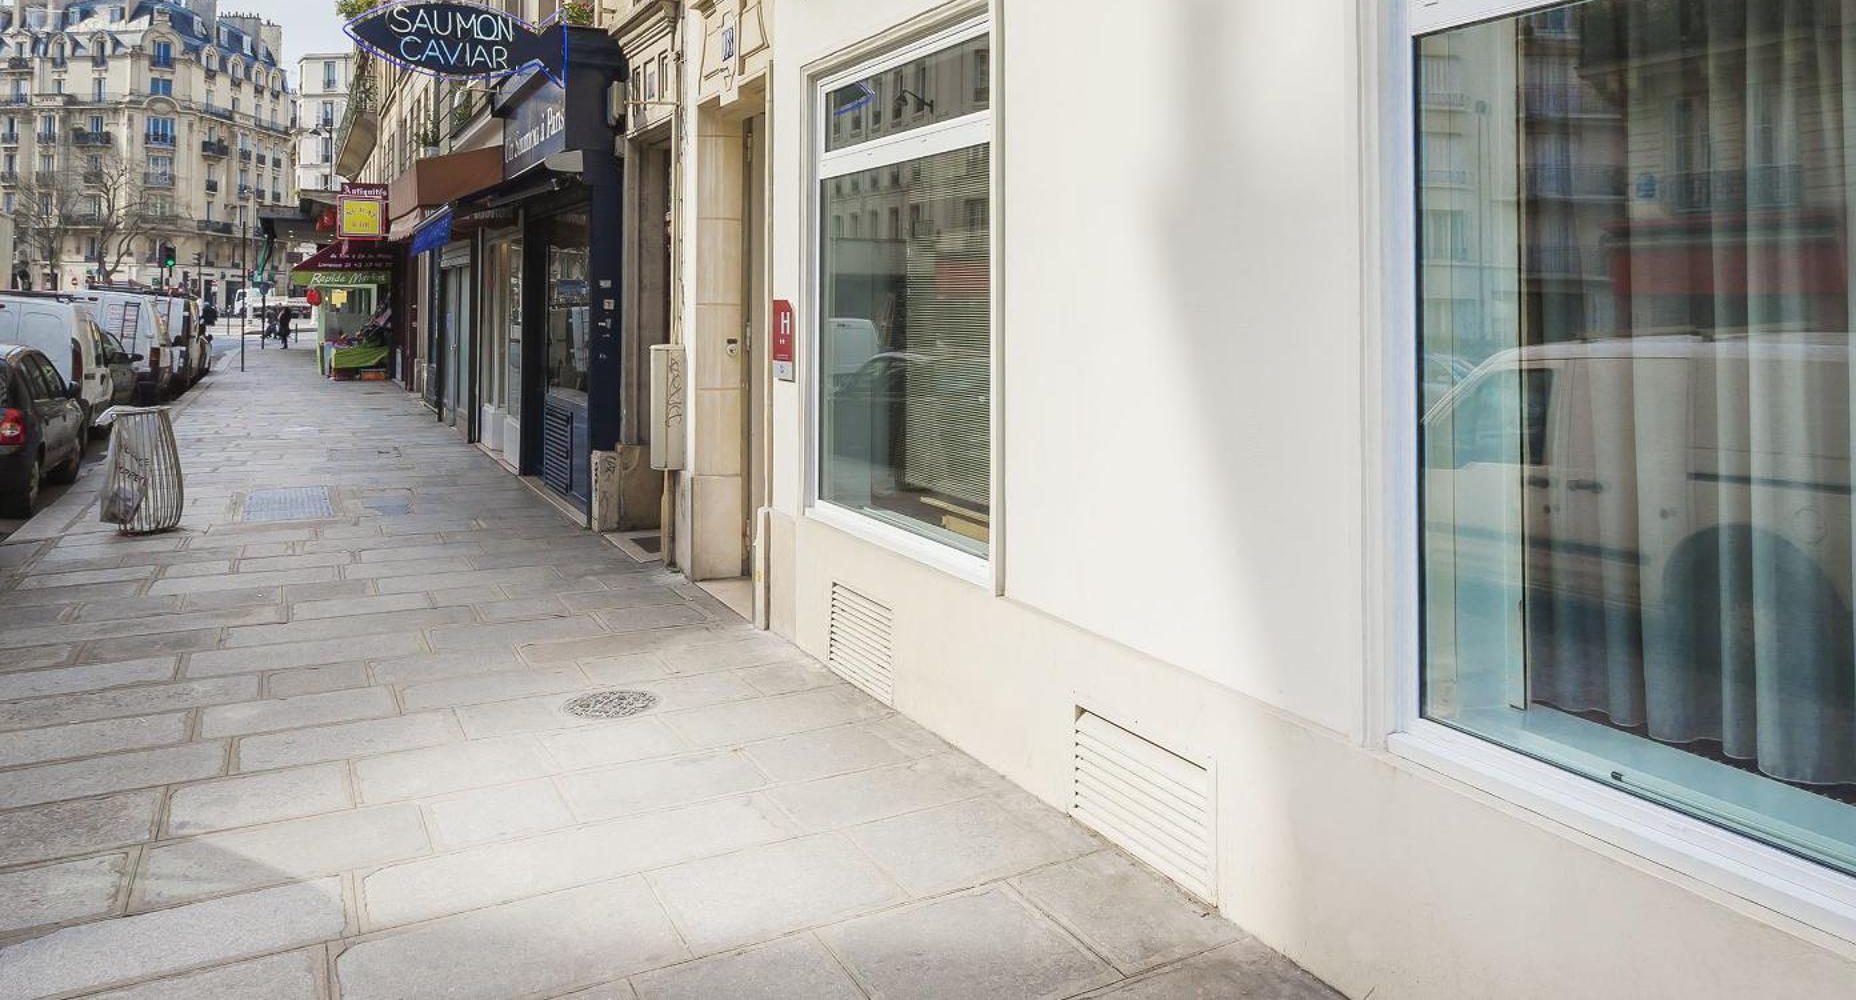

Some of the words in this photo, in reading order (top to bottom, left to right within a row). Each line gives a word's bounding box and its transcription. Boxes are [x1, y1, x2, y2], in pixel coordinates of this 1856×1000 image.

[390, 6, 513, 42] SAUMON
[400, 36, 508, 69] CAVIAR
[546, 107, 565, 139] Paris
[310, 272, 346, 285] Rapide
[780, 311, 790, 335] H
